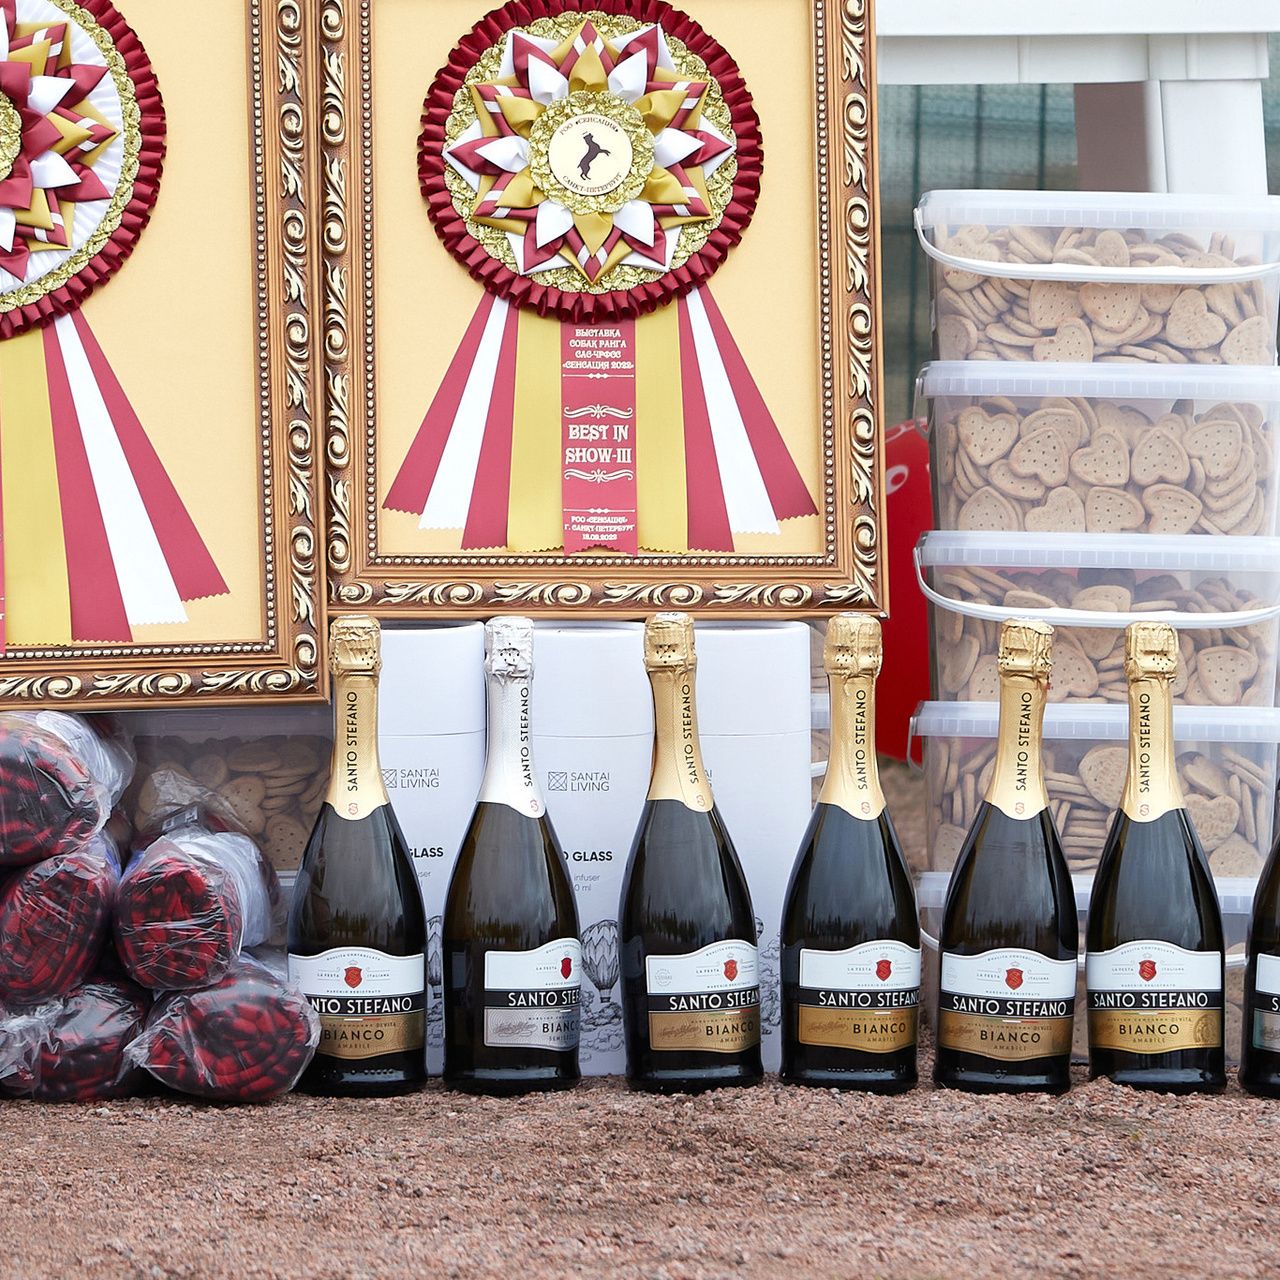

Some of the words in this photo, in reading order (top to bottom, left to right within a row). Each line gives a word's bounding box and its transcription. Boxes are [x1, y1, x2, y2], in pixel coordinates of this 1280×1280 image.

[575, 329, 621, 338] ВЫСТАВКА
[569, 339, 598, 349] СОБАК
[599, 340, 627, 348] РАНГА
[568, 424, 609, 442] BEST
[612, 425, 629, 443] IN
[565, 447, 632, 465] SHOW-III
[347, 691, 358, 746] STEFANO
[520, 687, 529, 741] STEFANO
[682, 684, 693, 740] STEFANO
[856, 690, 866, 745] STEFANO
[1018, 692, 1032, 746] STEFANO
[1139, 693, 1151, 748] STEFANO
[347, 751, 358, 791] SANTO
[520, 746, 533, 787] SANTO
[684, 744, 699, 784] SANTO
[856, 749, 868, 790] SANTO
[1016, 751, 1029, 791] SANTO
[1139, 752, 1151, 793] SANTO
[400, 769, 440, 778] SANTAI
[570, 772, 610, 782] SANTAI
[400, 779, 440, 789] LIVING
[570, 782, 610, 792] LIVING
[572, 851, 613, 862] GLASS
[311, 998, 341, 1013] NTO
[347, 997, 412, 1014] STEFANO
[508, 992, 558, 1006] SANTO
[669, 994, 722, 1011] SANTO
[819, 991, 872, 1007] SANTO
[952, 996, 1000, 1014] SANTO
[1006, 1001, 1067, 1016] STEFANO
[1094, 993, 1136, 1007] SANTO
[1141, 992, 1209, 1007] STEFANO
[324, 1029, 384, 1041] BIANCO
[706, 1022, 754, 1036] BIANCO
[853, 1023, 906, 1034] BIANCO
[980, 1030, 1041, 1043] BIANCO
[1119, 1024, 1179, 1035] BIANCO
